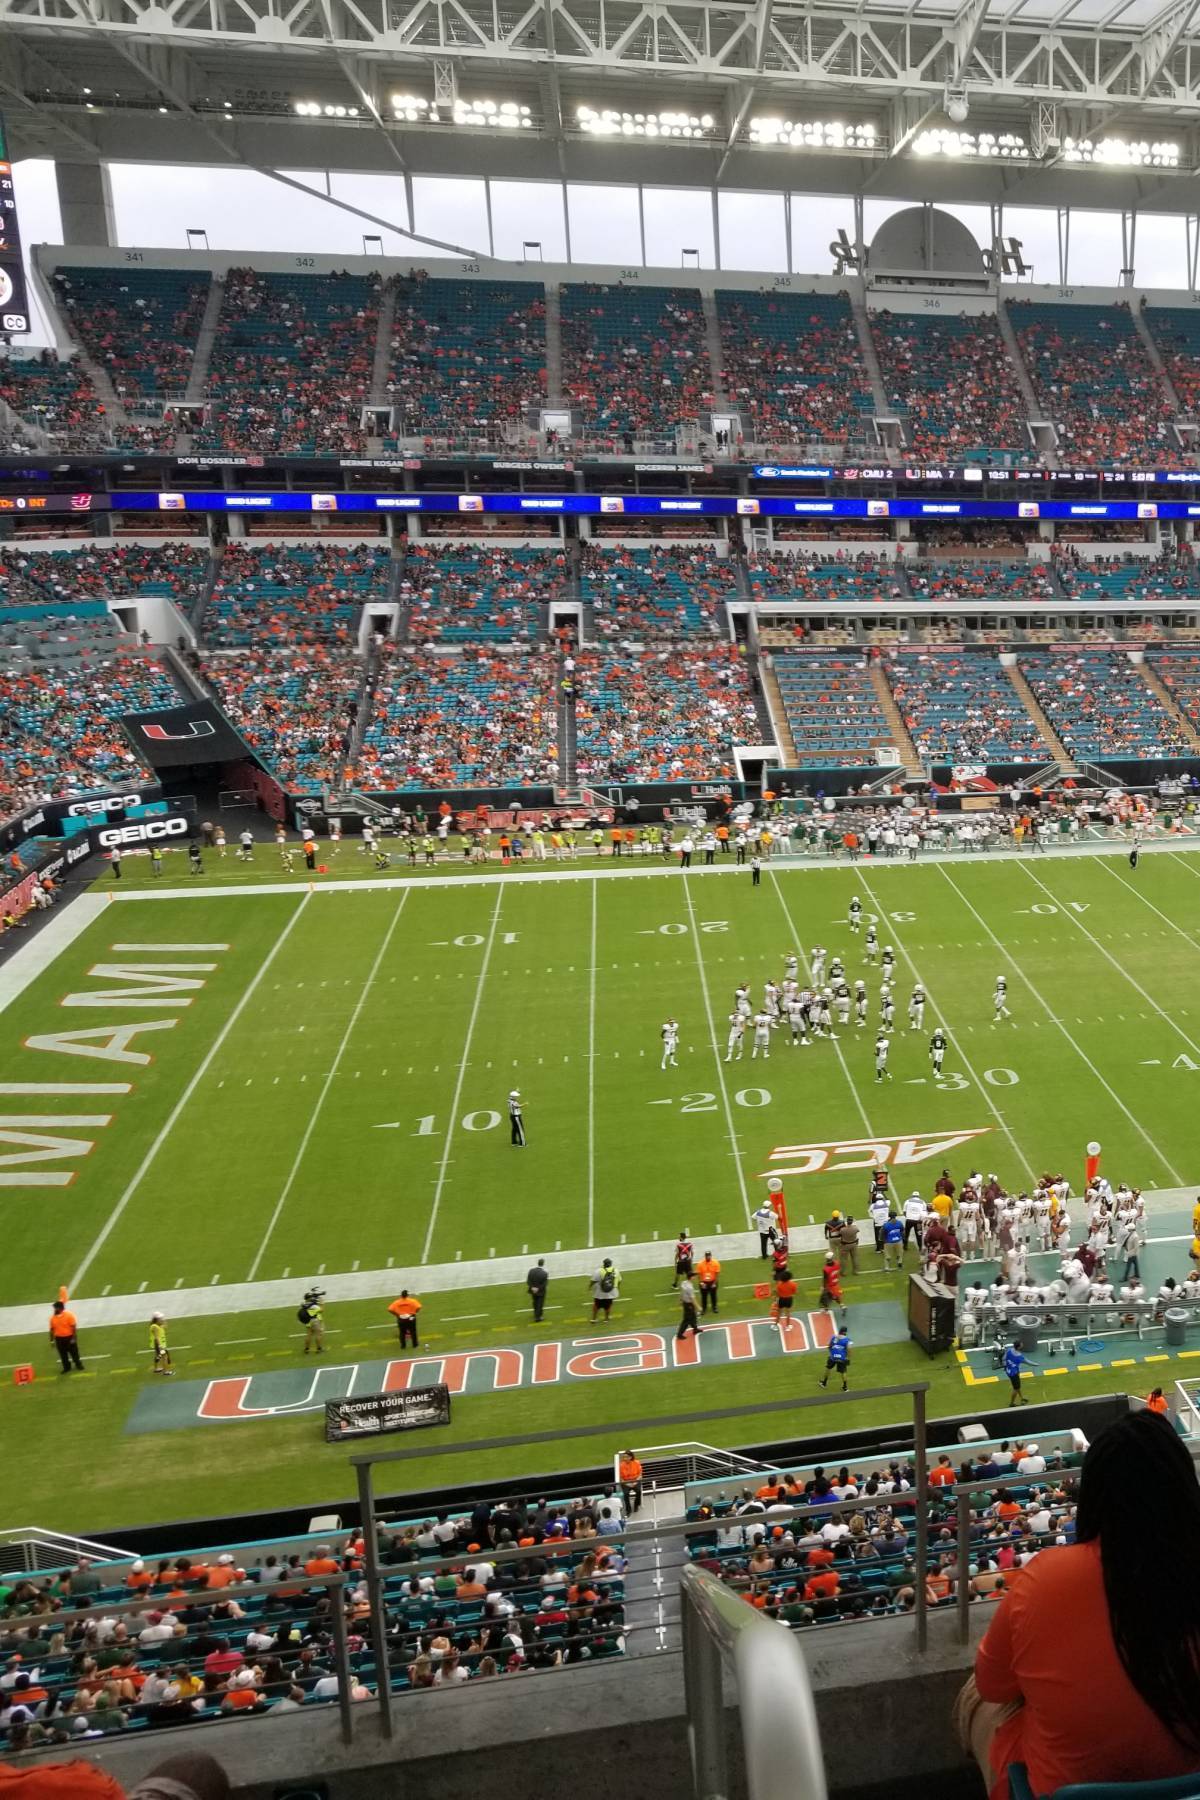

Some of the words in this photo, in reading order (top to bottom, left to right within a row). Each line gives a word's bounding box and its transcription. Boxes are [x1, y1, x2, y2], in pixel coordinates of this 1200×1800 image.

[125, 252, 144, 262] 341
[296, 257, 315, 268] 342
[461, 263, 480, 273] 343
[620, 270, 639, 279] 344
[774, 277, 791, 287] 345
[1058, 289, 1074, 299] 347
[923, 299, 941, 308] 346
[886, 470, 893, 478] 2
[949, 470, 955, 479] 7
[1050, 472, 1057, 480] 2
[68, 794, 142, 817] GEICO
[98, 816, 188, 848] GEICO
[1031, 902, 1091, 915] 40
[659, 920, 730, 935] 20
[453, 931, 524, 947] 10
[0, 943, 232, 1188] MIAMI
[935, 1068, 1020, 1091] 30
[680, 1088, 772, 1113] 20
[410, 1110, 502, 1137] 10
[339, 1401, 379, 1414] RECOVER
[380, 1396, 404, 1408] YOUR
